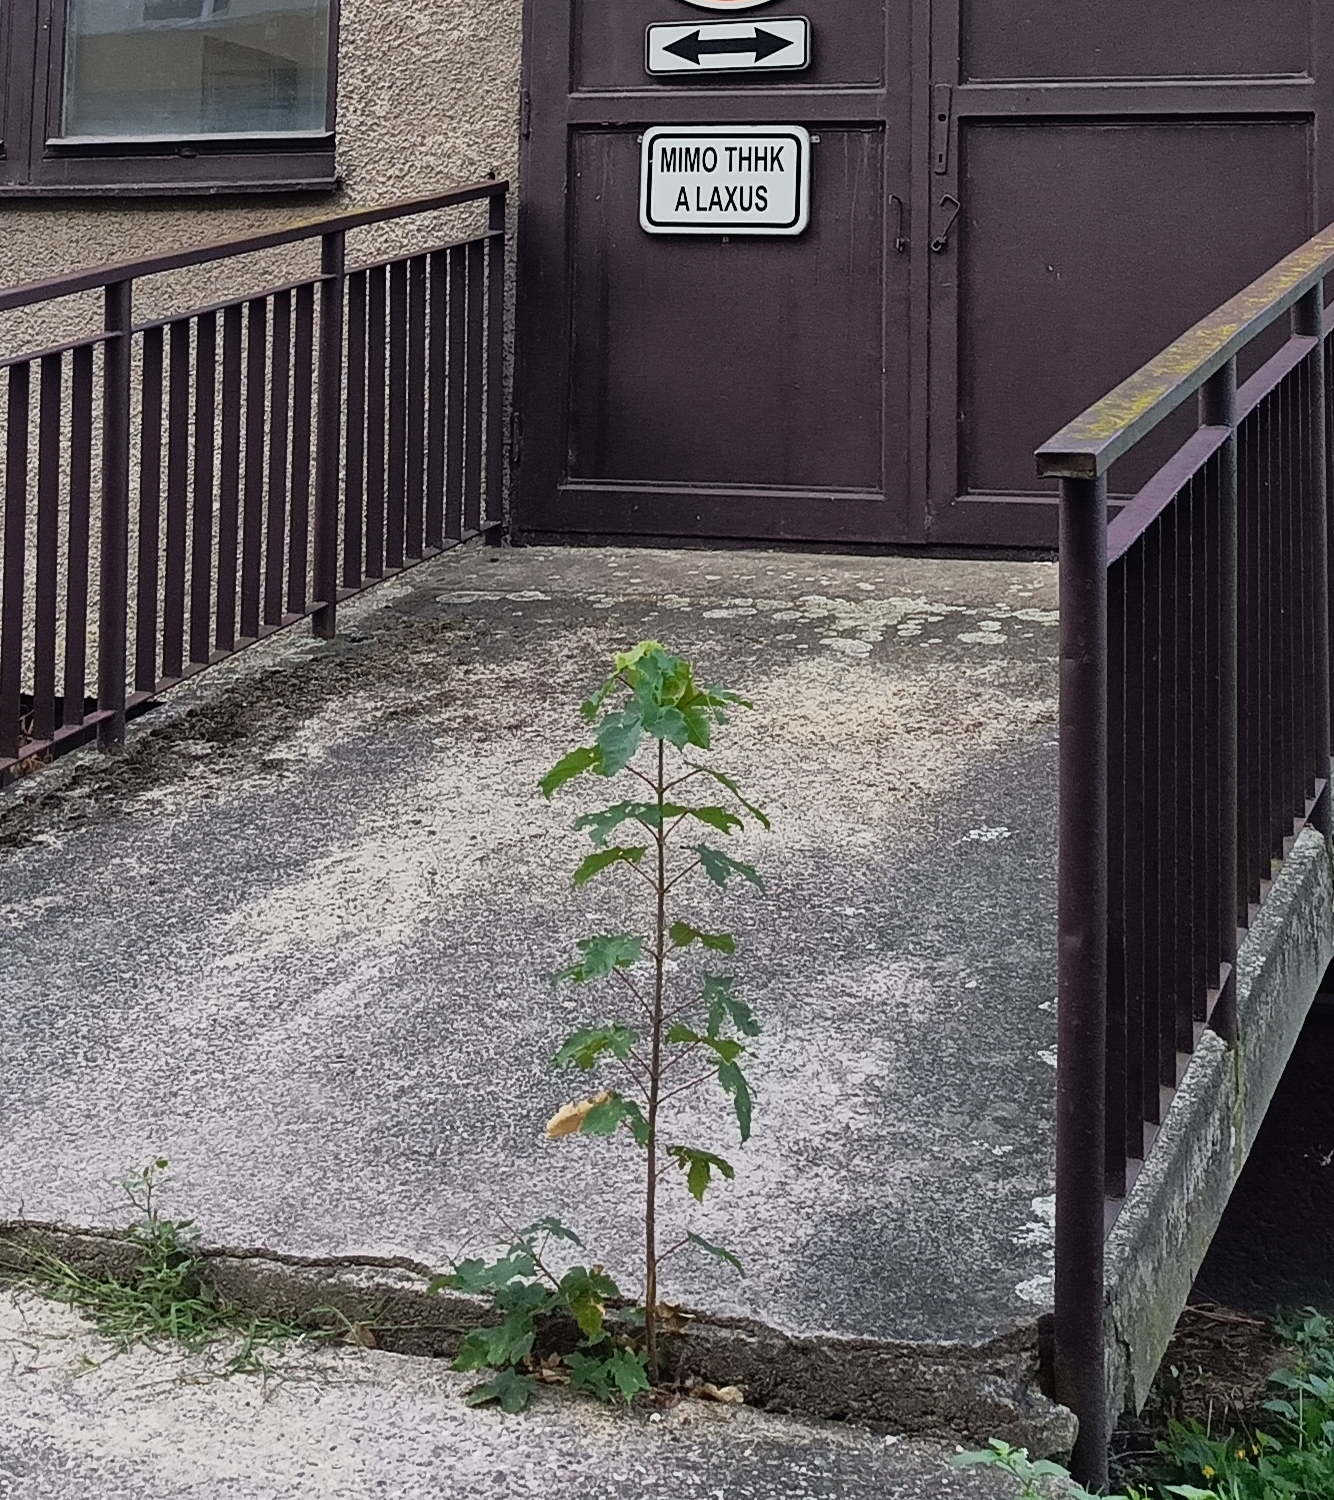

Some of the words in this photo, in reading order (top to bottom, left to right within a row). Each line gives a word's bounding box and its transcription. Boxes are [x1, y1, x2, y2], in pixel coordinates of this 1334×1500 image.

[660, 146, 718, 173] MIMO
[724, 145, 785, 172] THHK
[674, 186, 690, 212] A
[696, 185, 768, 212] LAXUS
